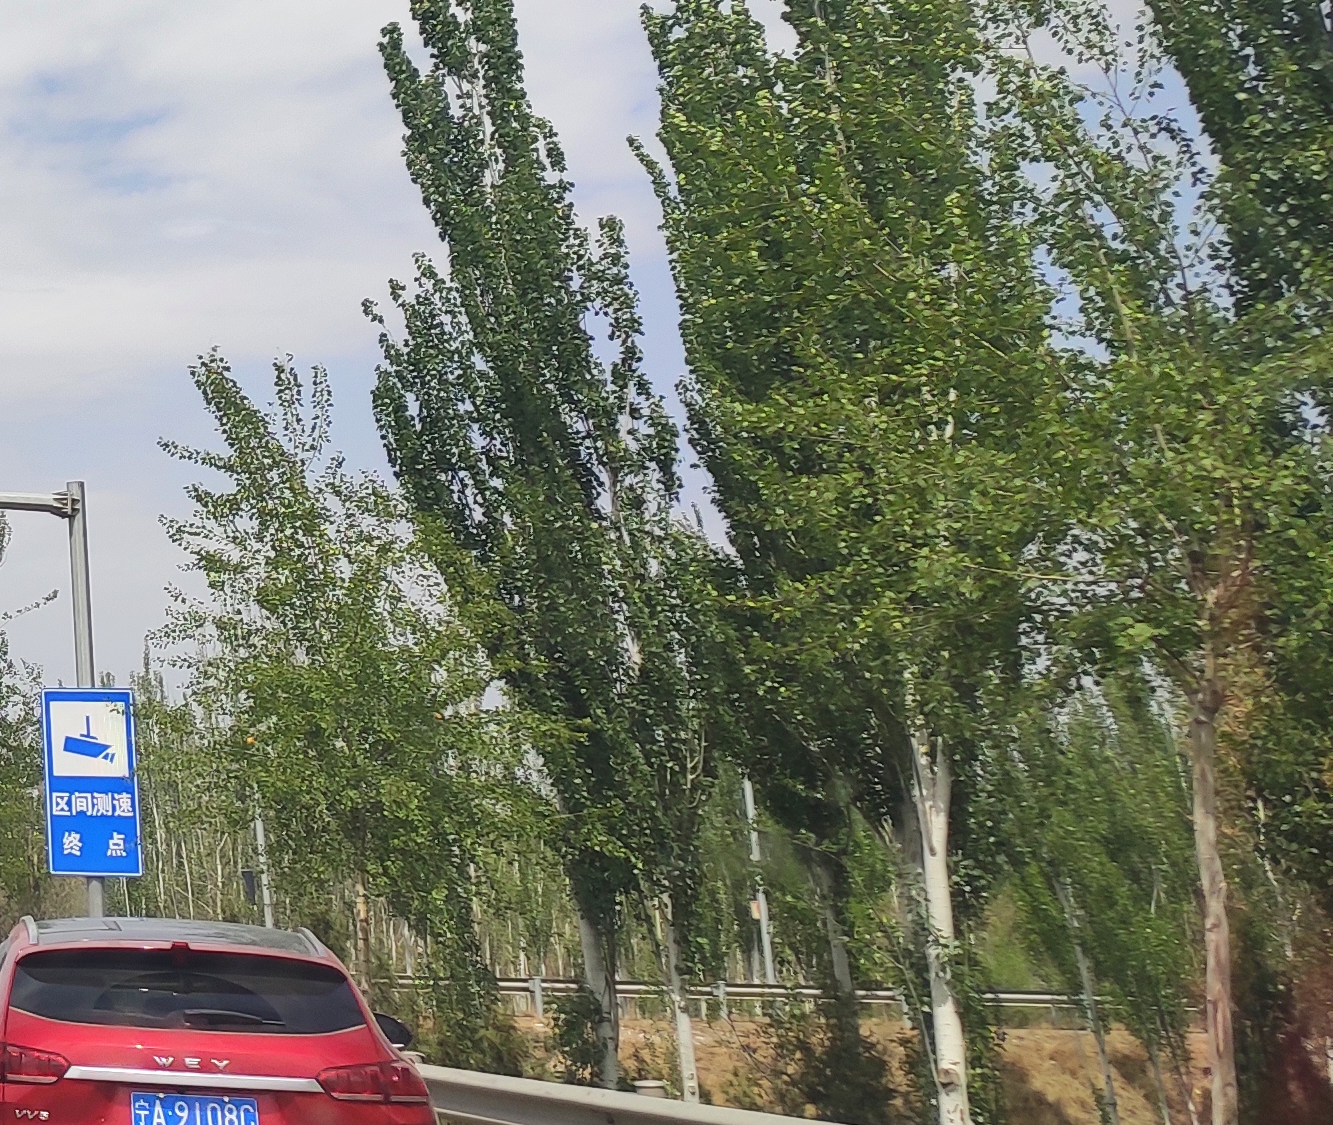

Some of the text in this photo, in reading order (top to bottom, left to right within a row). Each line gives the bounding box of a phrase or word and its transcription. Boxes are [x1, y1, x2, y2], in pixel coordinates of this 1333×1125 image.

[52, 792, 134, 816] 区间测速
[153, 1055, 230, 1071] WEY
